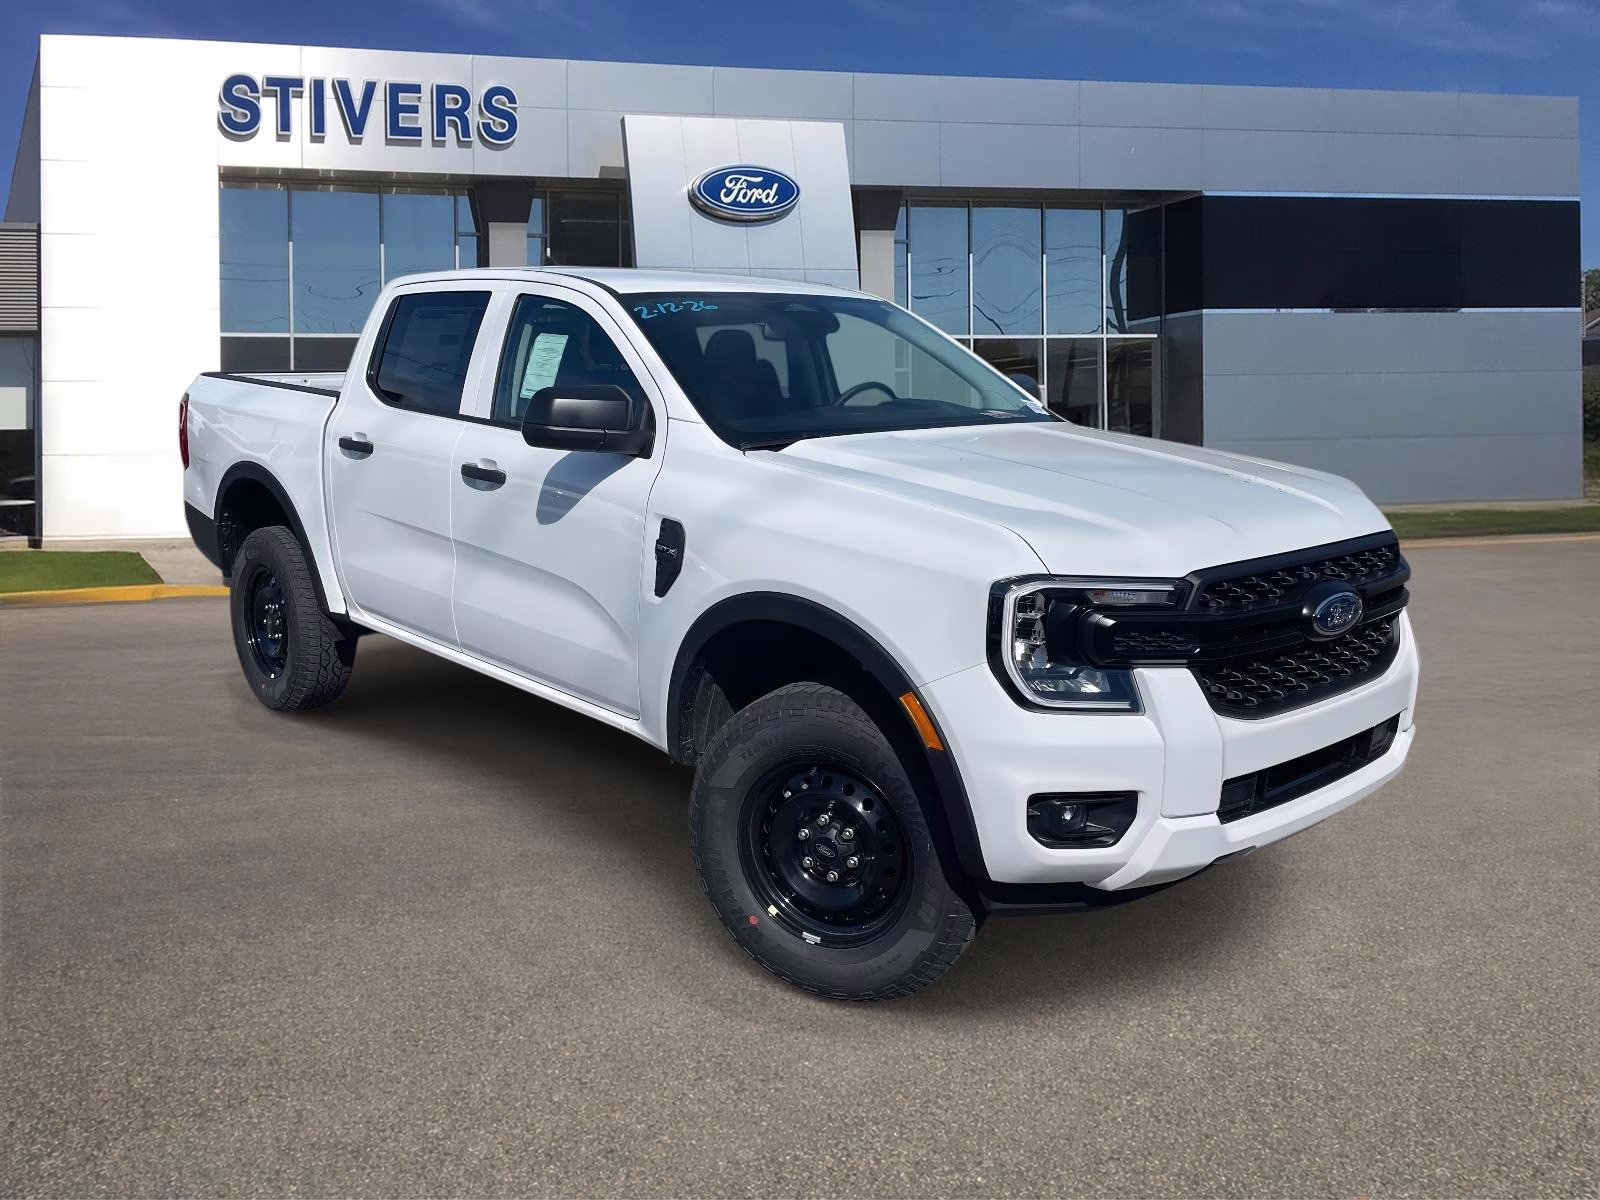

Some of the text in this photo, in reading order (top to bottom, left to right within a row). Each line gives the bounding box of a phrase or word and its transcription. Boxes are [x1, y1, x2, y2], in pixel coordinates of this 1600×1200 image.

[218, 73, 519, 146] STIVERS
[720, 174, 779, 204] Ford
[1327, 603, 1356, 627] Ford
